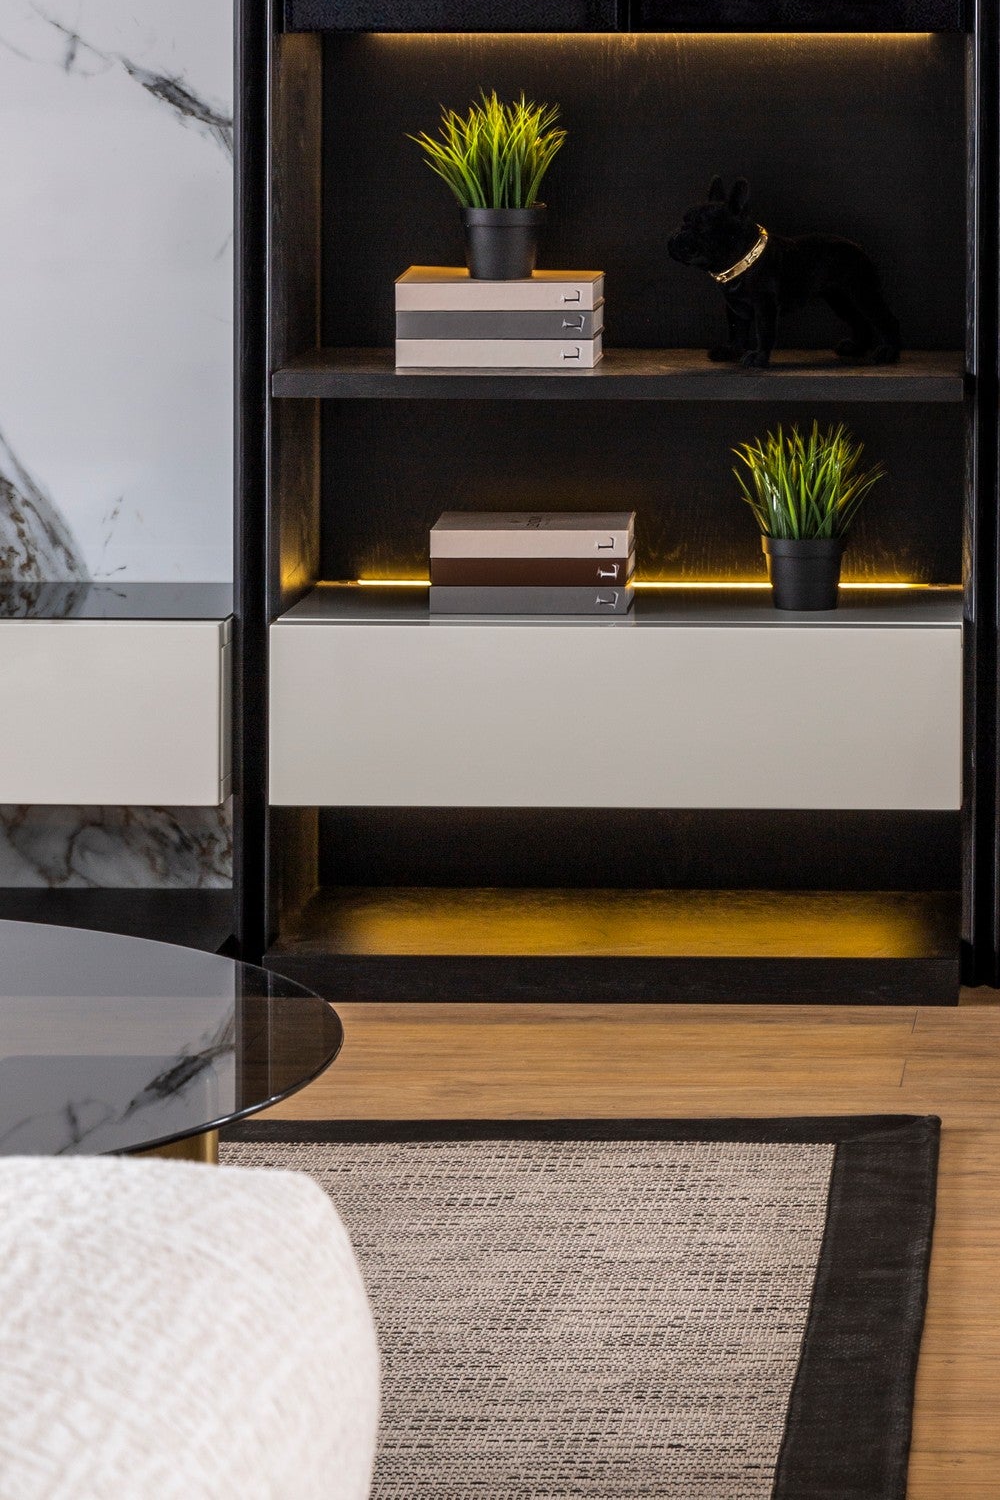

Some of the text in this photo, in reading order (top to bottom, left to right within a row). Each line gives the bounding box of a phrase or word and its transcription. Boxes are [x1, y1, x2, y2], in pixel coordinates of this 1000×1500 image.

[562, 289, 582, 304] L
[561, 314, 585, 333] L
[562, 346, 581, 361] L
[596, 536, 615, 551] L
[596, 563, 620, 580] L
[595, 591, 619, 610] L
